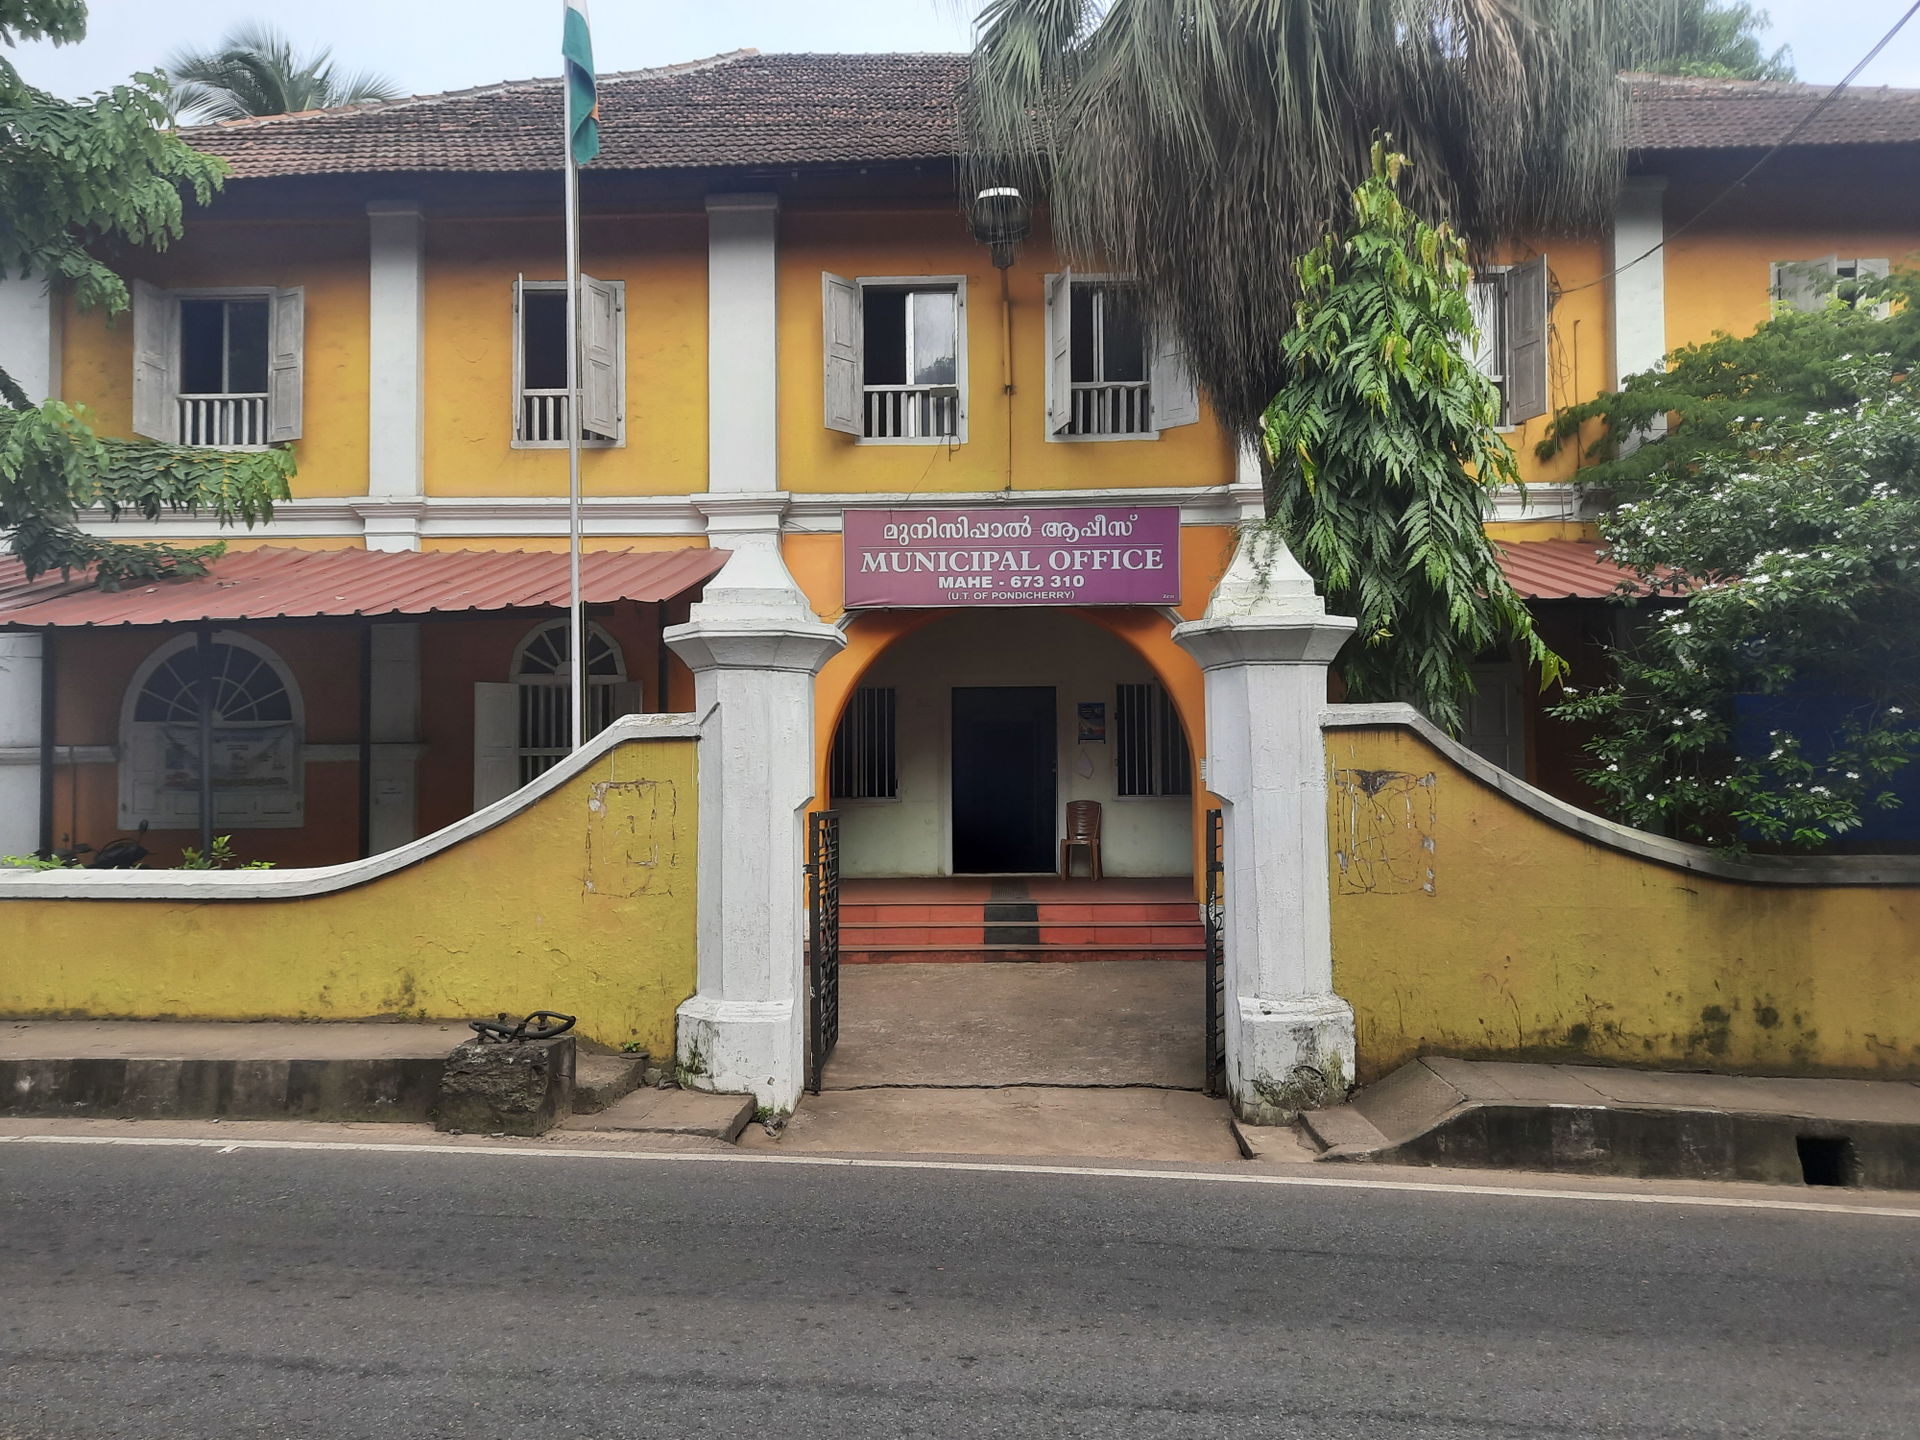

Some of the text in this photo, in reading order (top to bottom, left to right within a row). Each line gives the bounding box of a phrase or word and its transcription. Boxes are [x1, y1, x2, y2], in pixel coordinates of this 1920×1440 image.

[1041, 513, 1139, 543] ആപ്പീസ്
[860, 549, 1164, 573] MUNICIPAL OFFICE
[938, 576, 993, 589] MAHE
[1010, 575, 1044, 588] 673
[1050, 575, 1085, 588] 310
[947, 590, 1075, 601] (U.T. OF PONDICHERRY)
